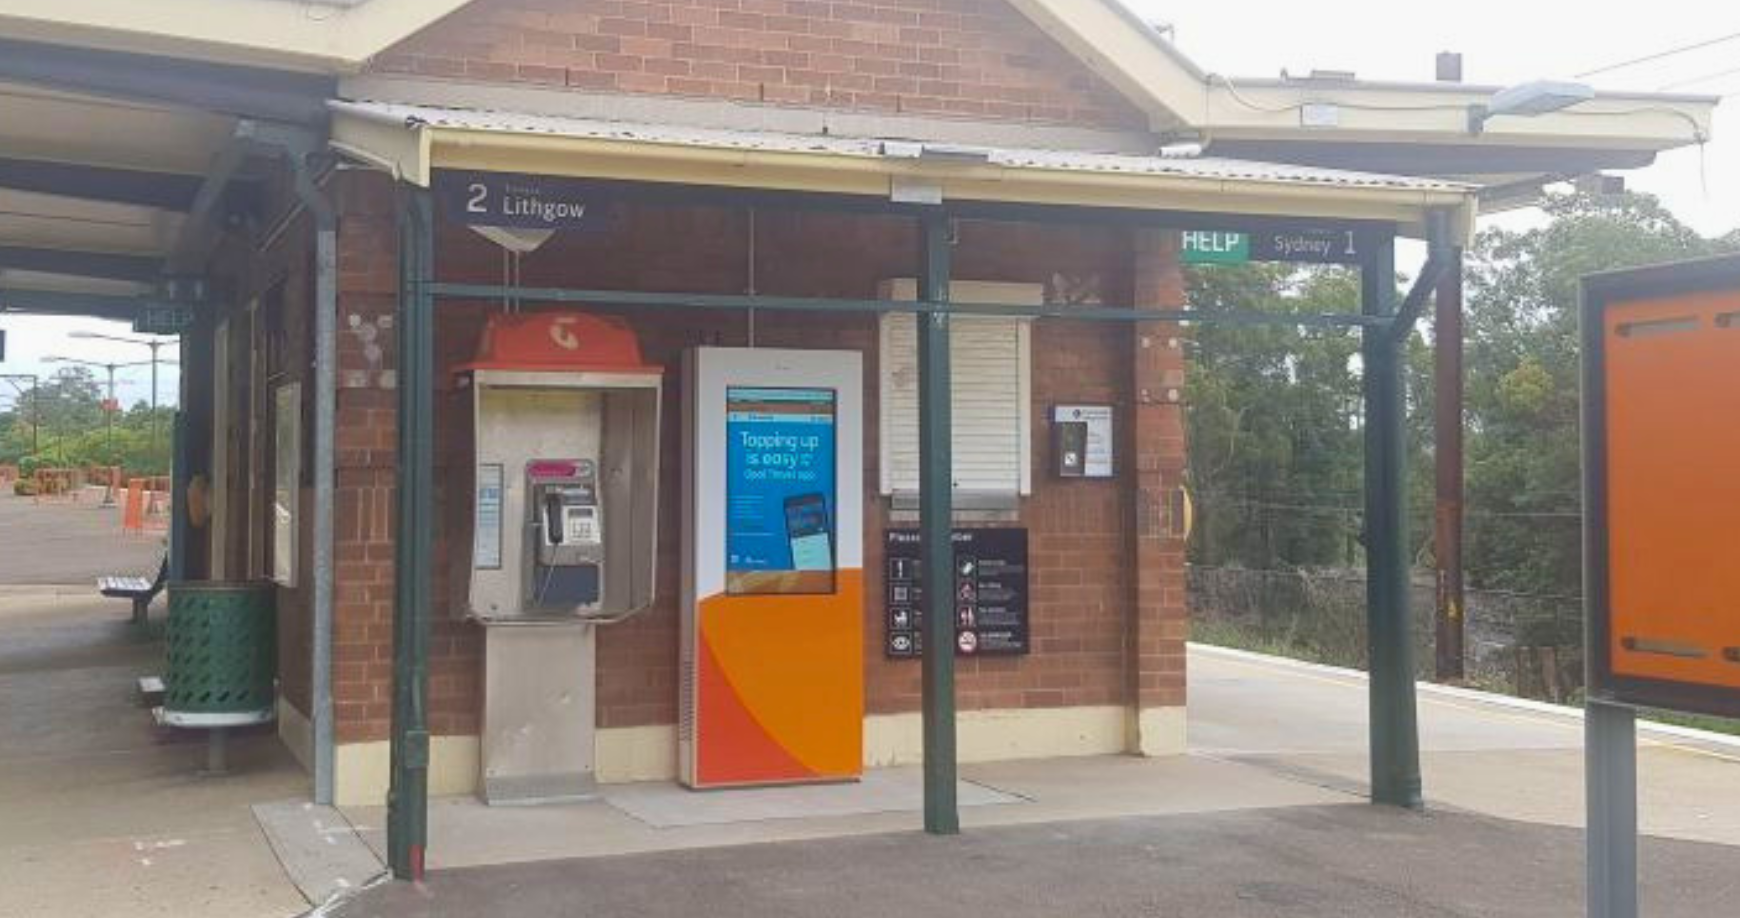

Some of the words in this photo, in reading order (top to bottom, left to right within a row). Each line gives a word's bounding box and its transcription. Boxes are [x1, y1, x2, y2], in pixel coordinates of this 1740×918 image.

[466, 183, 488, 213] 2
[502, 196, 585, 222] Lithgow
[1181, 230, 1239, 252] HELP
[1274, 234, 1331, 256] Sydney
[1343, 231, 1357, 255] 1
[739, 430, 799, 452] Topping
[800, 436, 819, 452] up
[762, 453, 798, 469] easy
